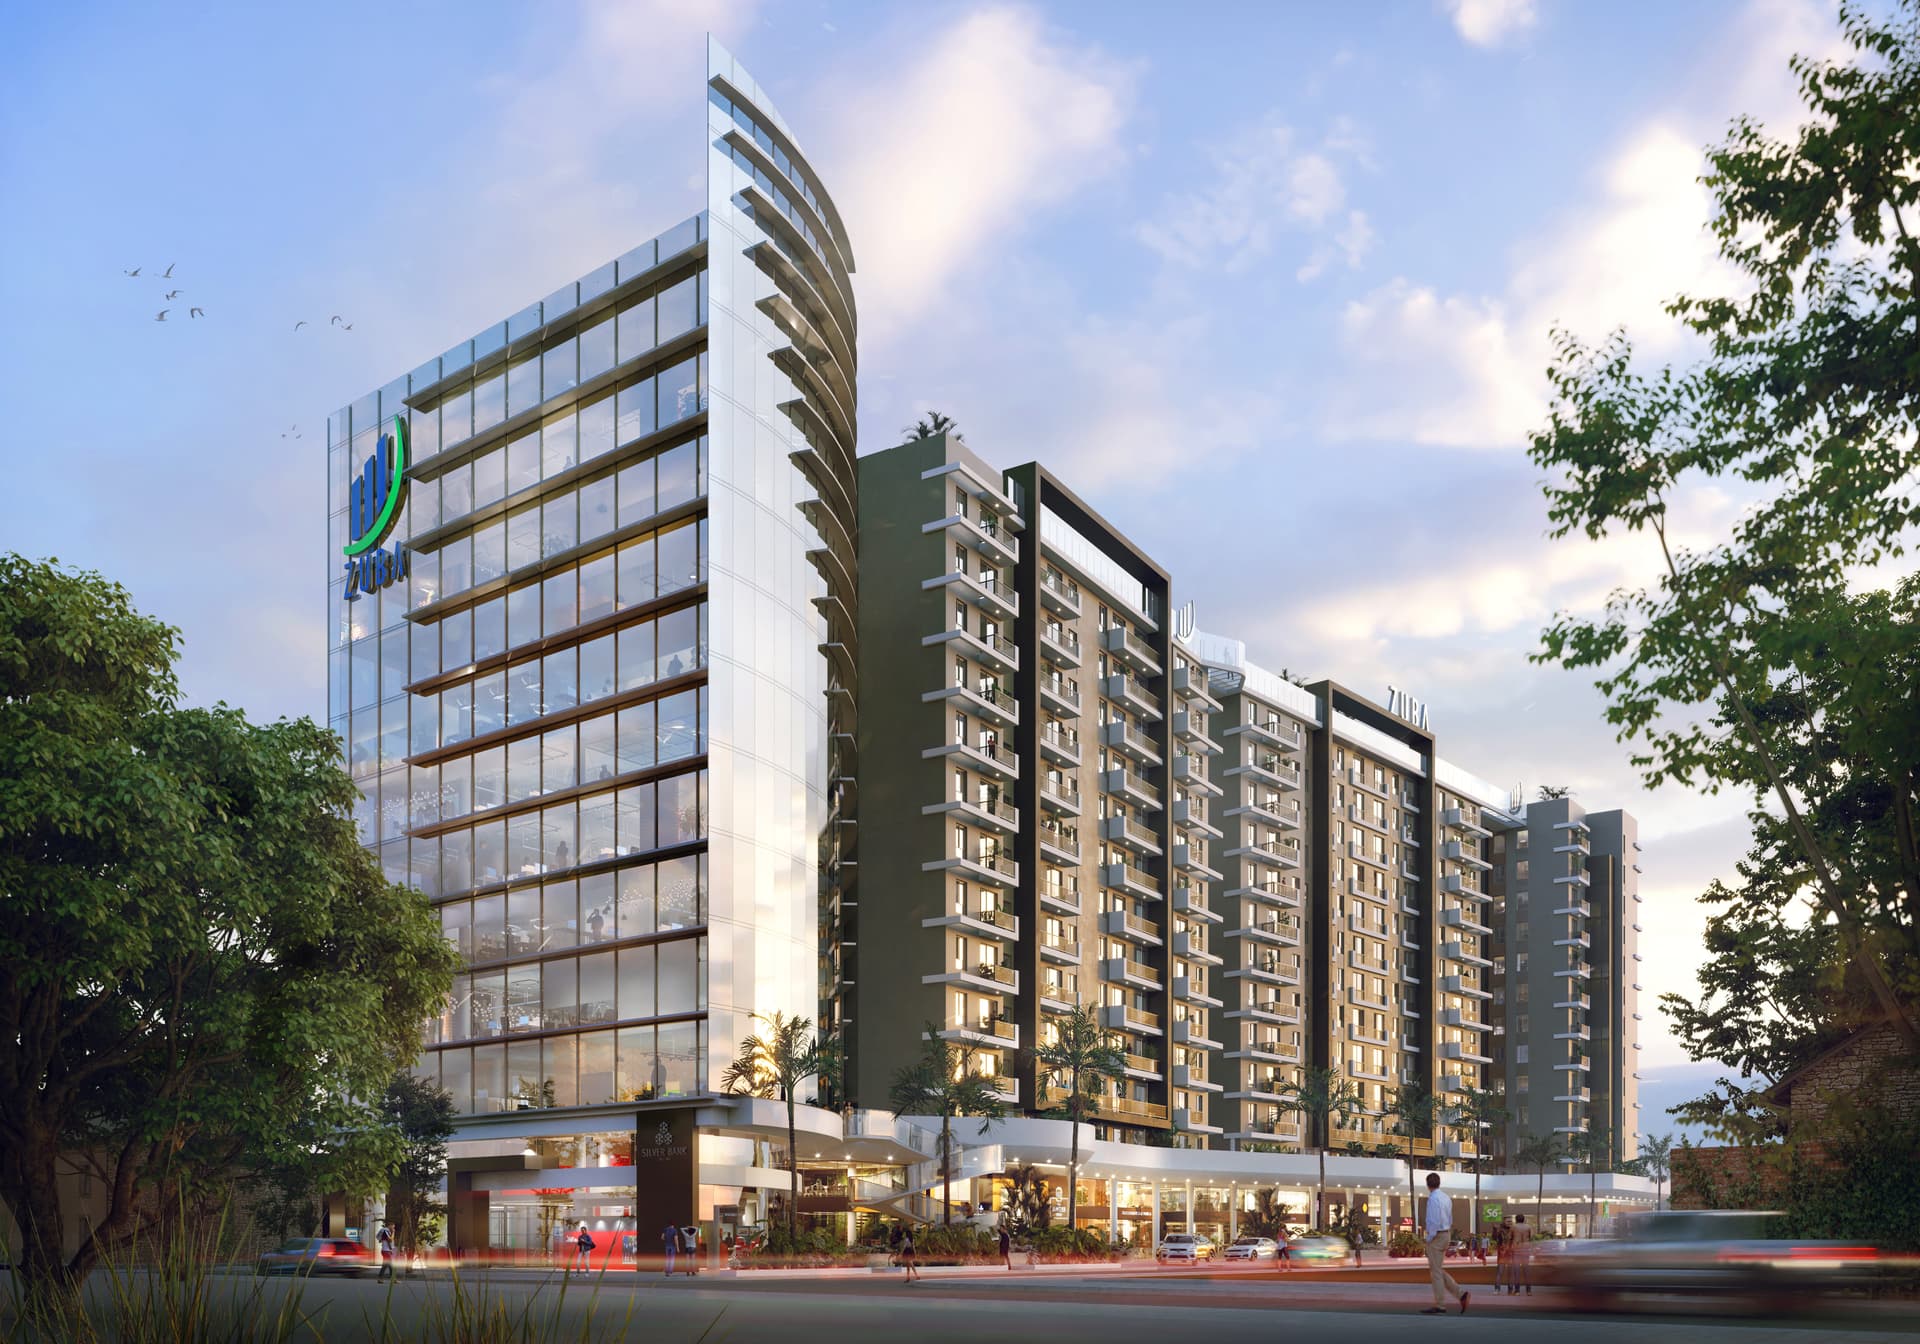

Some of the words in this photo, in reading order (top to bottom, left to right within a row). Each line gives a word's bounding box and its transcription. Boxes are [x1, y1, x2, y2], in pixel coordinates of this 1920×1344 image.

[343, 541, 408, 601] ZUBA
[1387, 685, 1430, 732] ZUBA
[641, 1148, 666, 1158] SILVER
